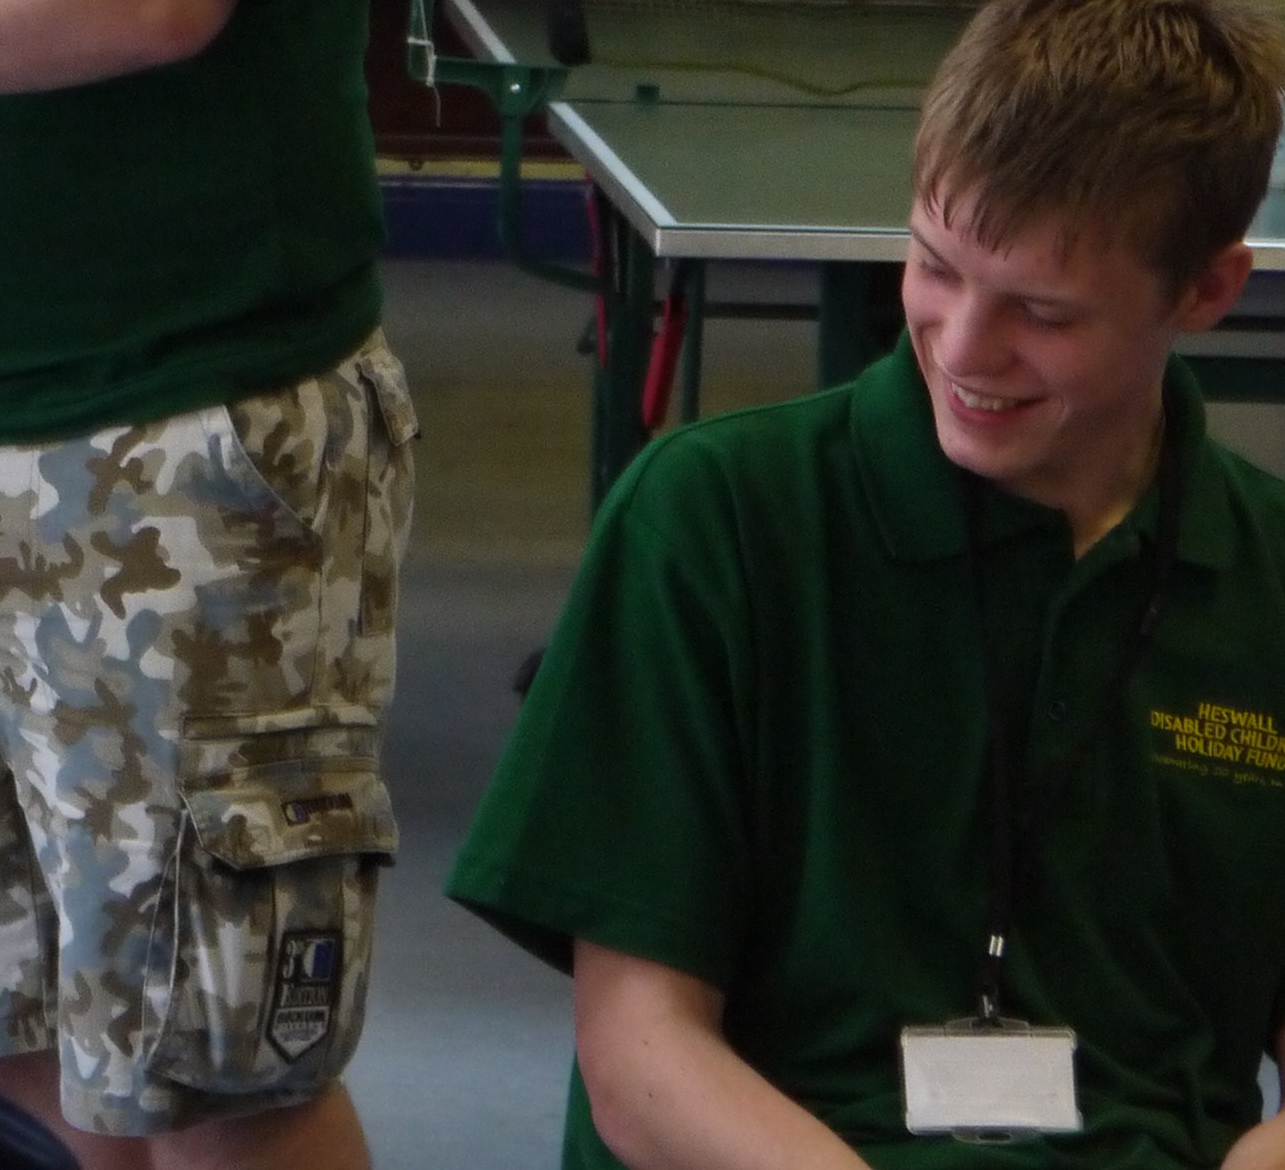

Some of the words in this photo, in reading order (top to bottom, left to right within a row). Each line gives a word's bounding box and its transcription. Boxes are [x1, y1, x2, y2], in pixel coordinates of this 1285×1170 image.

[1150, 710, 1227, 740] DISABLED
[1198, 702, 1278, 735] HESWALL
[1175, 733, 1244, 762] HOLIDAY
